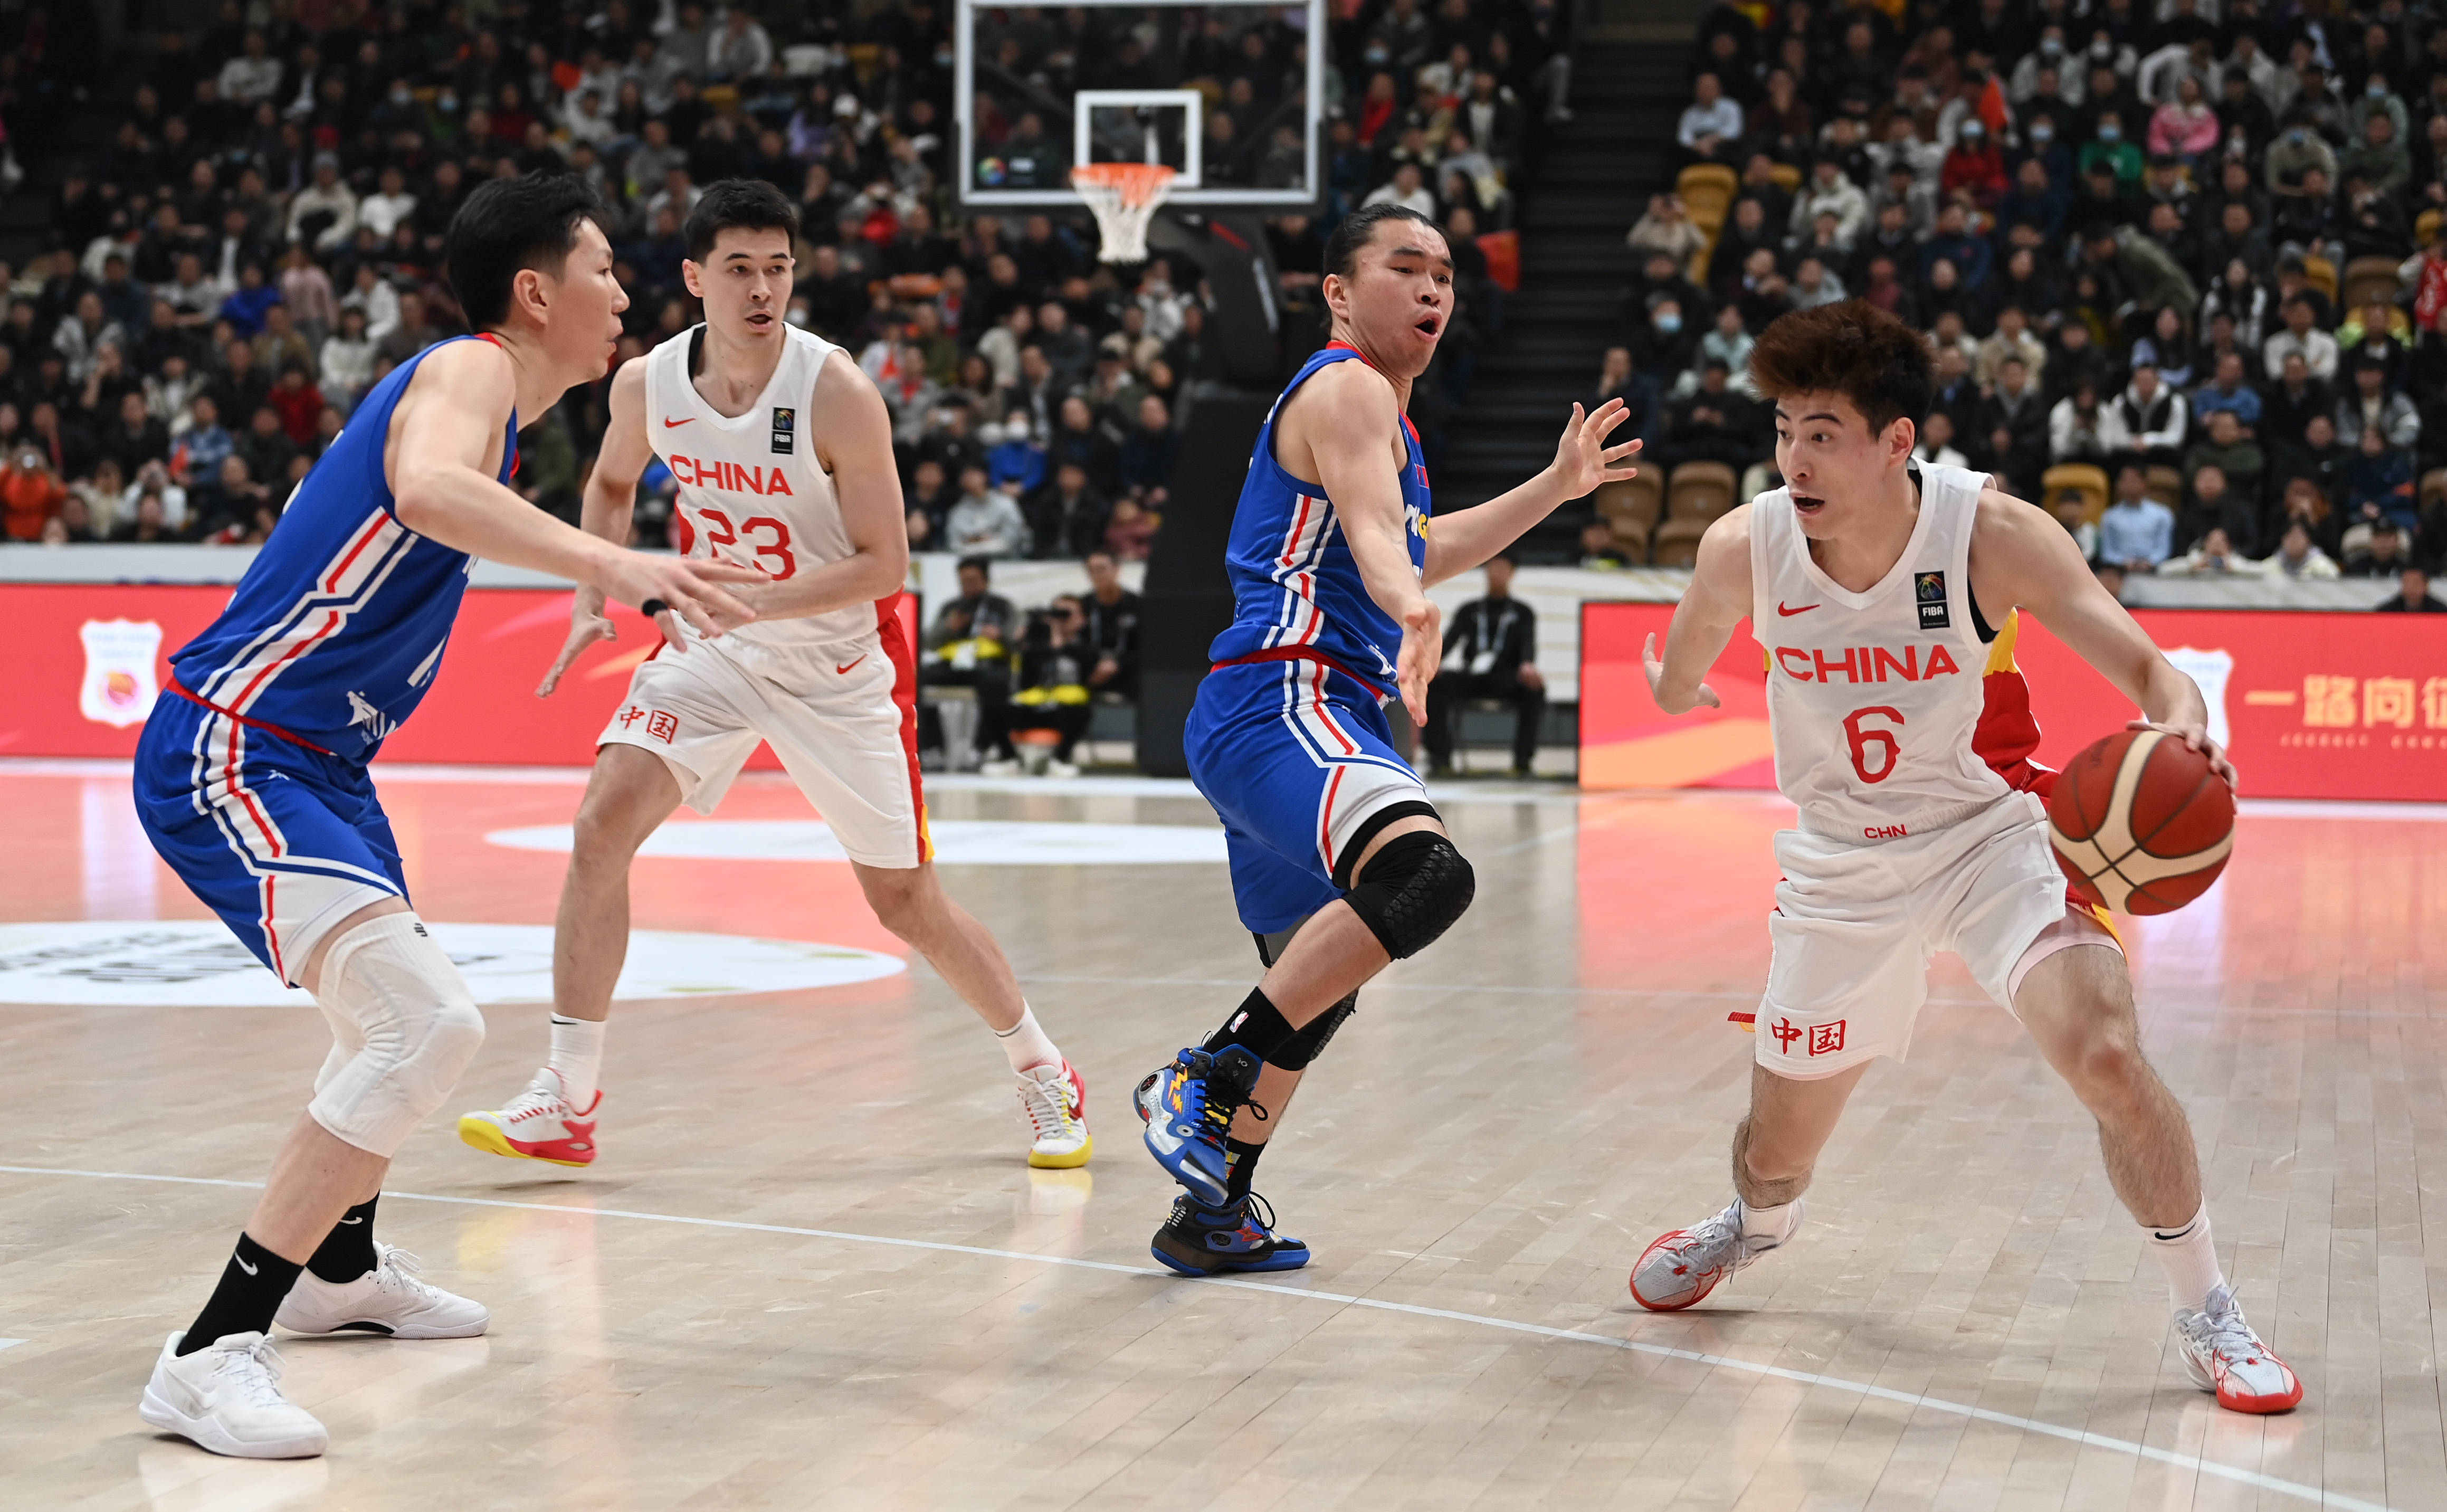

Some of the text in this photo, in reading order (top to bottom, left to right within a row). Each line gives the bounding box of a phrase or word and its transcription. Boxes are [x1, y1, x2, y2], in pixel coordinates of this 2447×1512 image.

[670, 454, 794, 496] CHINA
[699, 508, 797, 581] 23
[1922, 606, 1944, 616] FIBA
[1775, 644, 1960, 683] CHINA
[621, 706, 679, 744] 中国
[1842, 706, 1905, 784] 6
[1864, 824, 1907, 839] CHN
[1771, 1017, 1846, 1057] 中国
